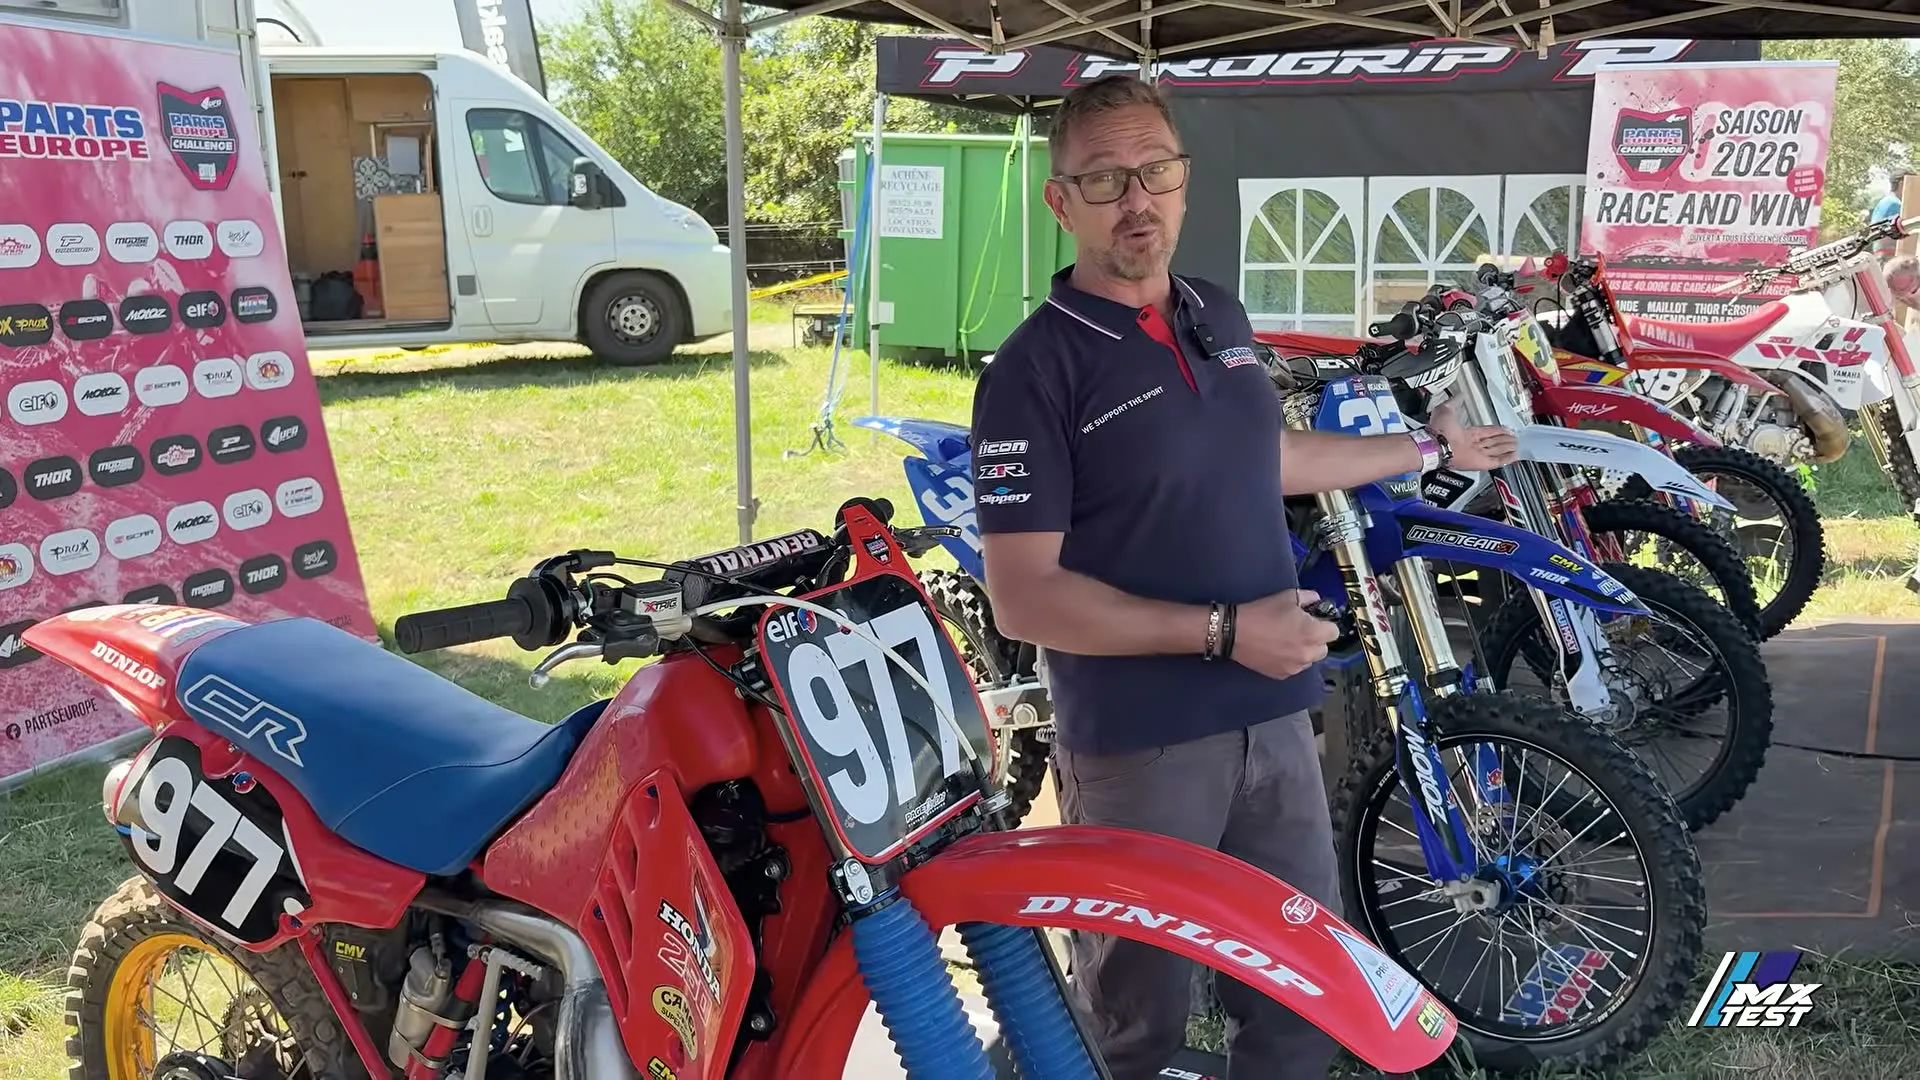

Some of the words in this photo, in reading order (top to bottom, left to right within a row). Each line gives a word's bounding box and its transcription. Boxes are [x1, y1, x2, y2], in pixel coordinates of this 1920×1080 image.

[930, 51, 1027, 82] P
[0, 102, 144, 138] PARTS
[170, 114, 225, 128] PARTS
[1716, 109, 1802, 135] SAISON
[173, 127, 227, 138] EUROPE
[1623, 128, 1682, 138] PARTS
[0, 135, 149, 158] EUROPE
[173, 138, 233, 152] CHALLENGE
[1619, 146, 1684, 154] CHALLENGE
[1711, 141, 1799, 177] 2026
[1597, 192, 1673, 224] RACE
[1677, 192, 1741, 225] AND
[1750, 192, 1813, 227] WIN
[174, 235, 204, 245] THOR
[1622, 280, 1633, 291] DE
[1670, 281, 1682, 292] DE
[187, 303, 208, 317] elf
[1647, 301, 1687, 314] MAILLOT
[1694, 302, 1721, 315] THOR
[1639, 320, 1694, 350] YAMAHA
[1419, 362, 1459, 387] UFO
[1832, 369, 1862, 380] YAMAHA
[19, 394, 44, 412] elf
[81, 385, 122, 401] MOTOZ
[1081, 421, 1095, 434] WE
[1094, 403, 1129, 427] SUPPORT
[1127, 394, 1144, 409] THE
[1142, 385, 1165, 402] SPORT
[34, 469, 72, 487] THOR
[979, 491, 1032, 505] Slippery
[232, 505, 254, 519] elf
[173, 514, 214, 532] MOTOZ
[50, 540, 89, 561] PROX
[701, 530, 819, 576] RENTHAL
[246, 564, 279, 583] THOR
[1549, 553, 1584, 573] CMV
[1529, 567, 1570, 585] THOR
[643, 597, 679, 614] XTRIG
[767, 614, 799, 644] elf
[1553, 600, 1567, 626] LIQUI
[1561, 624, 1578, 653] MOLY
[90, 640, 166, 691] DUNLOP
[25, 697, 98, 735] PARTSEUROPE
[184, 674, 305, 768] CR
[788, 601, 961, 824] 977
[1401, 724, 1449, 825] MOTOZ
[131, 757, 285, 930] 977
[335, 942, 367, 960] CMV
[659, 902, 721, 1004] HONDA
[1019, 895, 1325, 997] DUNLOP
[660, 990, 696, 1046] CAMEL
